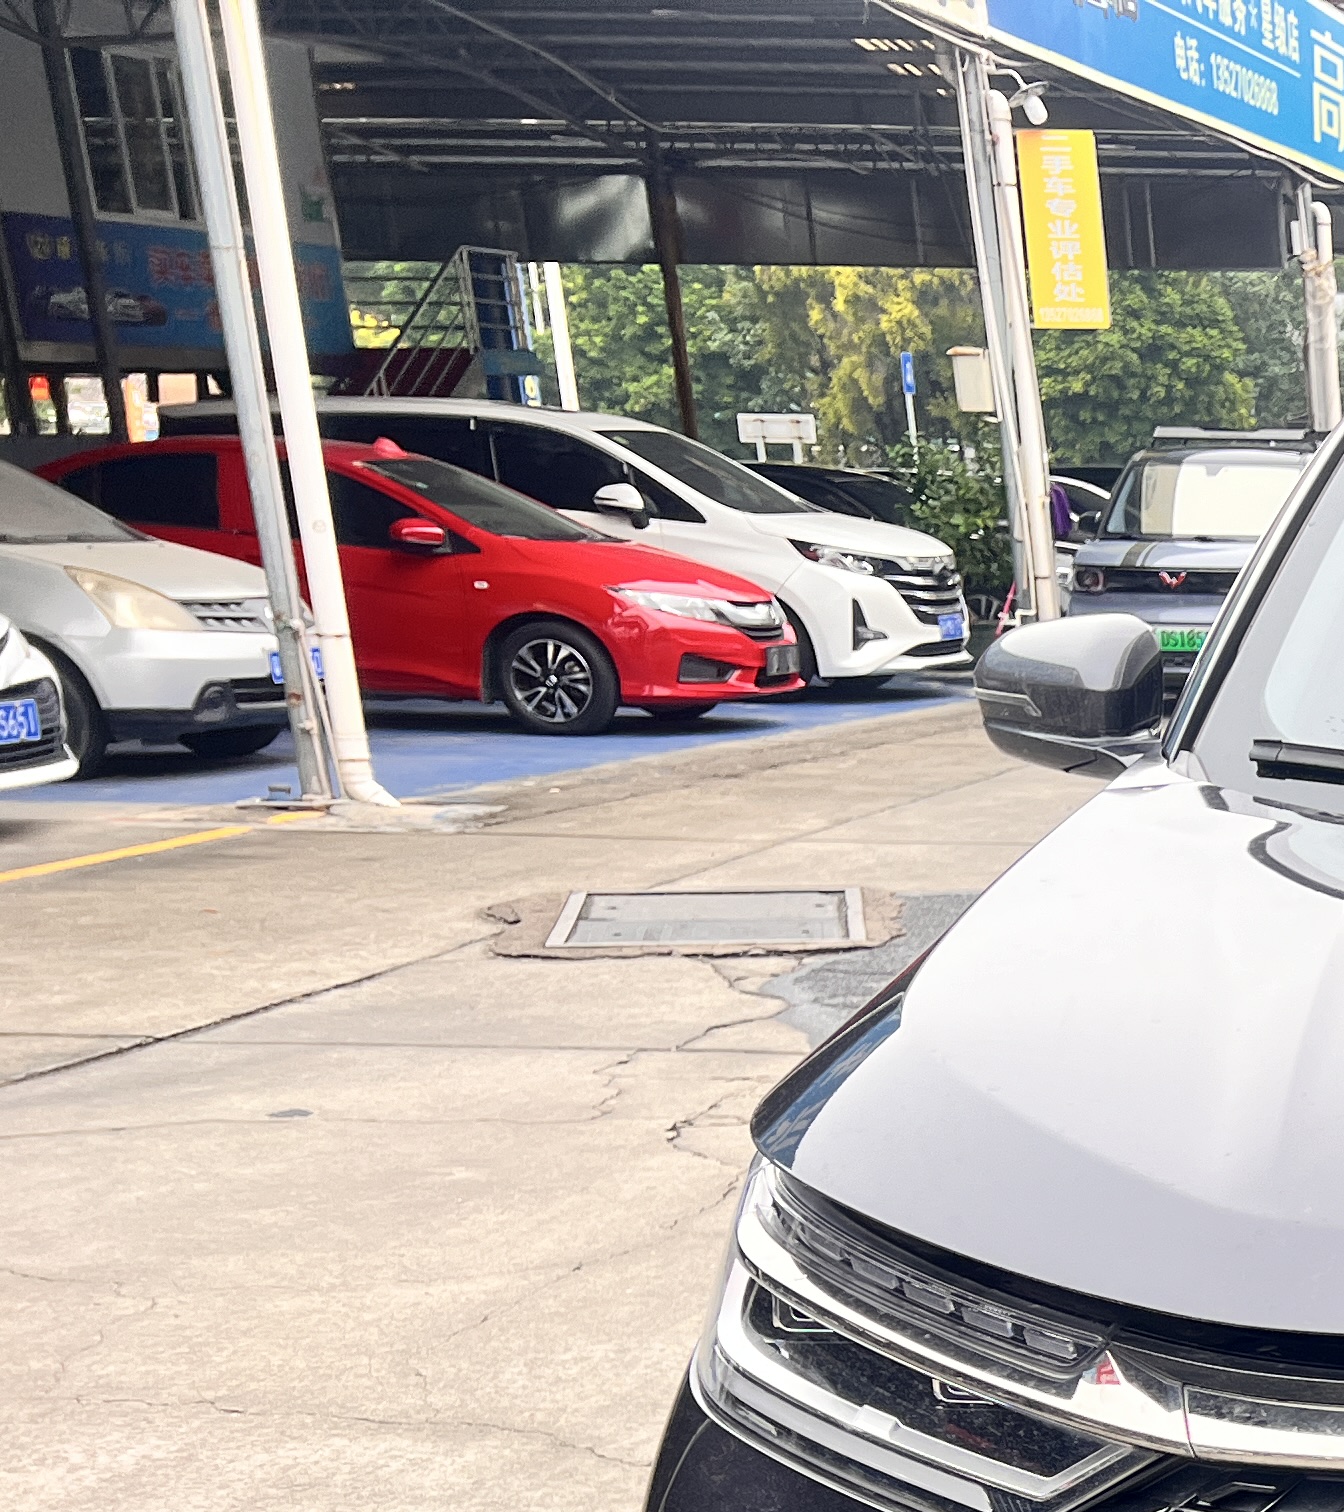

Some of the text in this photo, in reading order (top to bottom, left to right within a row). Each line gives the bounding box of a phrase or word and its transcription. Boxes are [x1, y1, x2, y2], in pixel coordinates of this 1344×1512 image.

[1039, 134, 1086, 303] 二手车专业评估处
